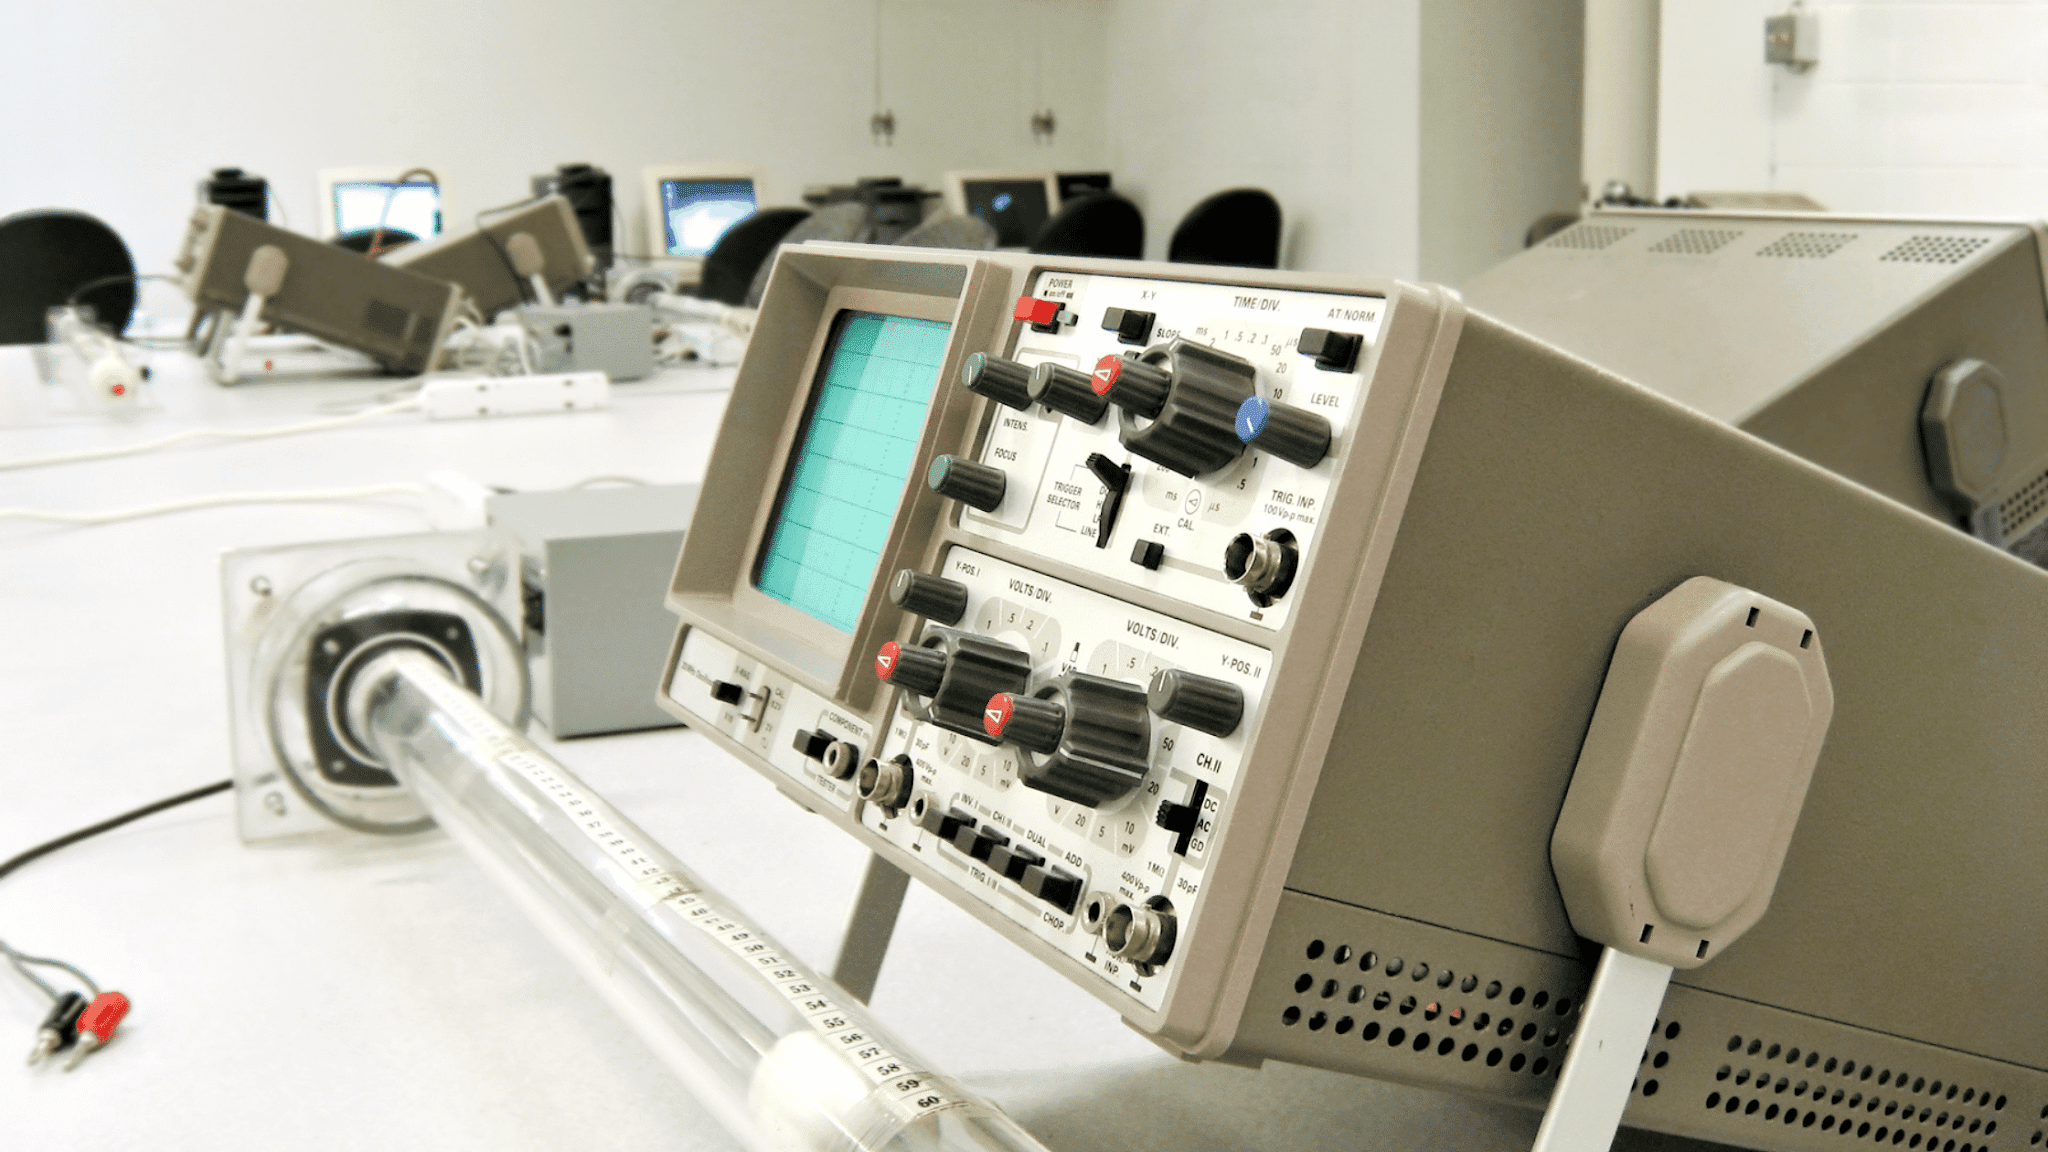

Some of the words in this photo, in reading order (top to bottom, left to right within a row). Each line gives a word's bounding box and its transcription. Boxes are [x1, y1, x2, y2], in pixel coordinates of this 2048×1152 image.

[1048, 278, 1073, 289] POWER
[1141, 290, 1157, 300] X-Y
[1233, 296, 1281, 312] TIME/DIV.
[1196, 327, 1208, 336] ms
[1224, 330, 1229, 340] 1
[1234, 331, 1244, 342] .5
[1247, 332, 1257, 344] .2
[1270, 344, 1282, 356] 50
[1275, 362, 1287, 374] 20
[1273, 388, 1283, 399] 10
[1310, 392, 1340, 408] LEVEL
[1003, 418, 1028, 432] INTENS.
[994, 447, 1018, 462] FOCUS
[1252, 457, 1258, 468] 1
[1053, 481, 1083, 497] TRIGGER
[1236, 478, 1247, 491] .5
[1165, 490, 1178, 501] ms
[1271, 489, 1294, 506] TRIG.
[1296, 494, 1316, 511] INP.
[1046, 494, 1081, 511] SELECTOR
[1153, 523, 1170, 538] EXT.
[1177, 518, 1195, 531] CAL.
[1080, 525, 1097, 539] LINE
[1008, 578, 1053, 604] VOLTS/DIV.
[986, 620, 992, 630] 1
[1126, 619, 1179, 650] VOLTS/DIV.
[1102, 663, 1107, 675] 1
[1127, 657, 1137, 669] .5
[1221, 654, 1252, 675] Y-POS.
[829, 711, 863, 736] COMPONENT
[1162, 737, 1175, 751] 50
[961, 755, 971, 768] 20
[1003, 760, 1012, 772] 10
[980, 765, 986, 776] 5
[1147, 781, 1160, 796] 20
[1054, 805, 1061, 815] V
[1203, 798, 1218, 813] DC
[1075, 814, 1086, 827] 20
[1196, 818, 1211, 833] AC
[1099, 826, 1105, 838] 5
[1125, 821, 1135, 835] 10
[1026, 829, 1046, 848] DUAL
[1190, 838, 1204, 852] GD
[1121, 843, 1135, 854] mV
[1064, 851, 1083, 868] ADD
[1043, 911, 1065, 933] CHOP.
[744, 944, 764, 952] 50
[758, 956, 778, 965] 51
[773, 969, 796, 979] 52
[1104, 960, 1119, 977] INP.
[789, 984, 811, 994] 53
[805, 1000, 828, 1011] 54
[823, 1017, 845, 1029] 55
[840, 1033, 863, 1045] 56
[858, 1047, 880, 1059] 57
[877, 1063, 901, 1076] 58
[896, 1079, 920, 1092] 59
[917, 1095, 940, 1108] 60
